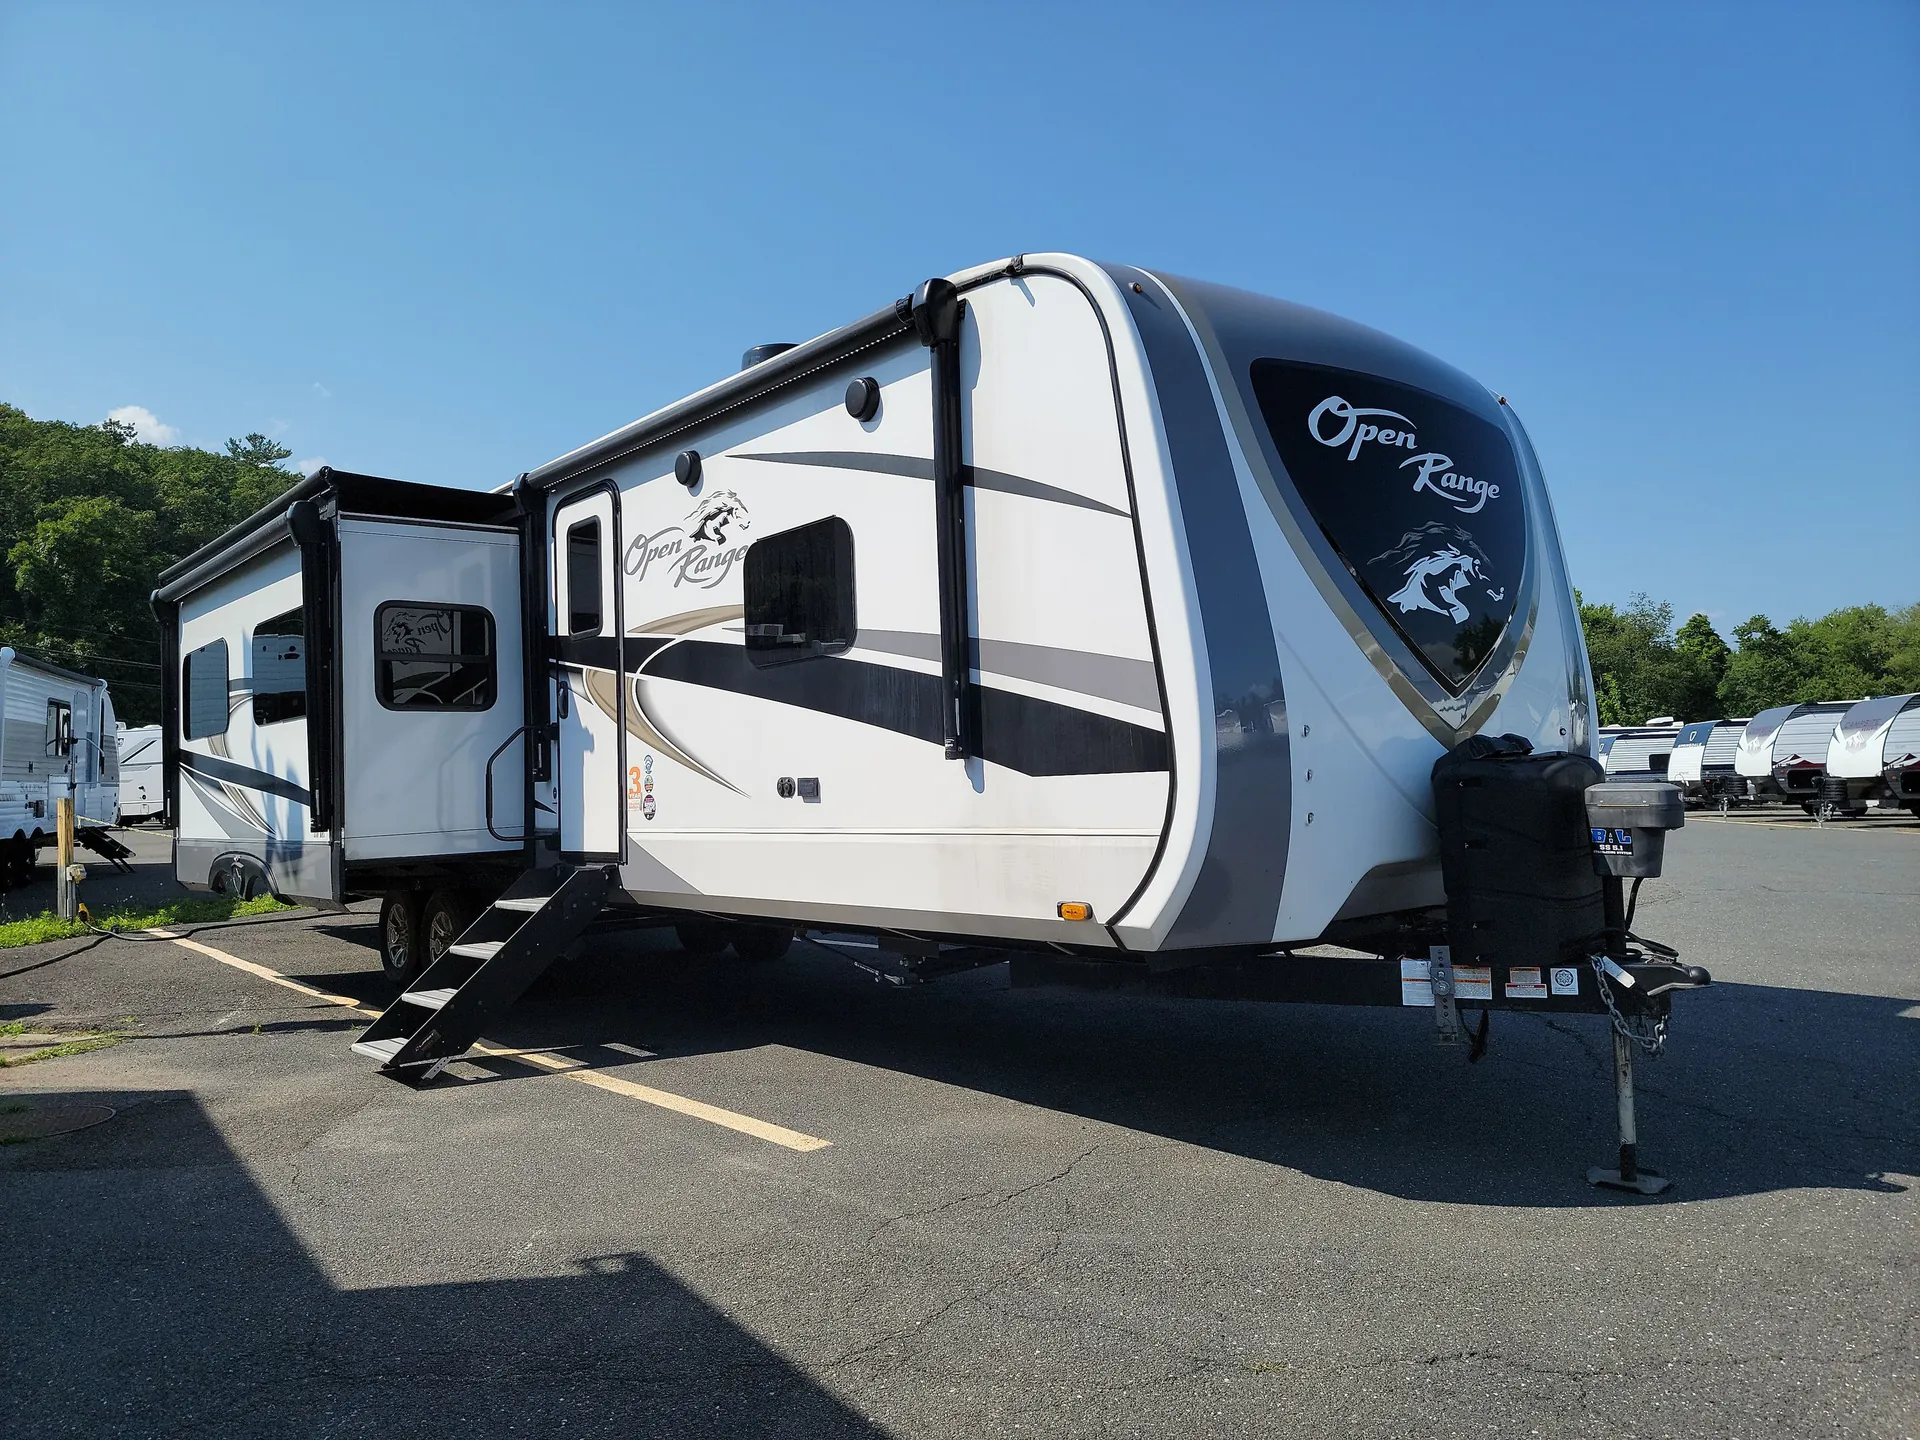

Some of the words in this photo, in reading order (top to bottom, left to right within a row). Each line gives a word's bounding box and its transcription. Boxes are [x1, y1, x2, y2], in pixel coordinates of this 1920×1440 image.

[1308, 396, 1417, 460] Open
[1399, 453, 1500, 513] Range
[624, 526, 685, 582] Open
[667, 545, 748, 589] Range
[629, 767, 641, 793] 3
